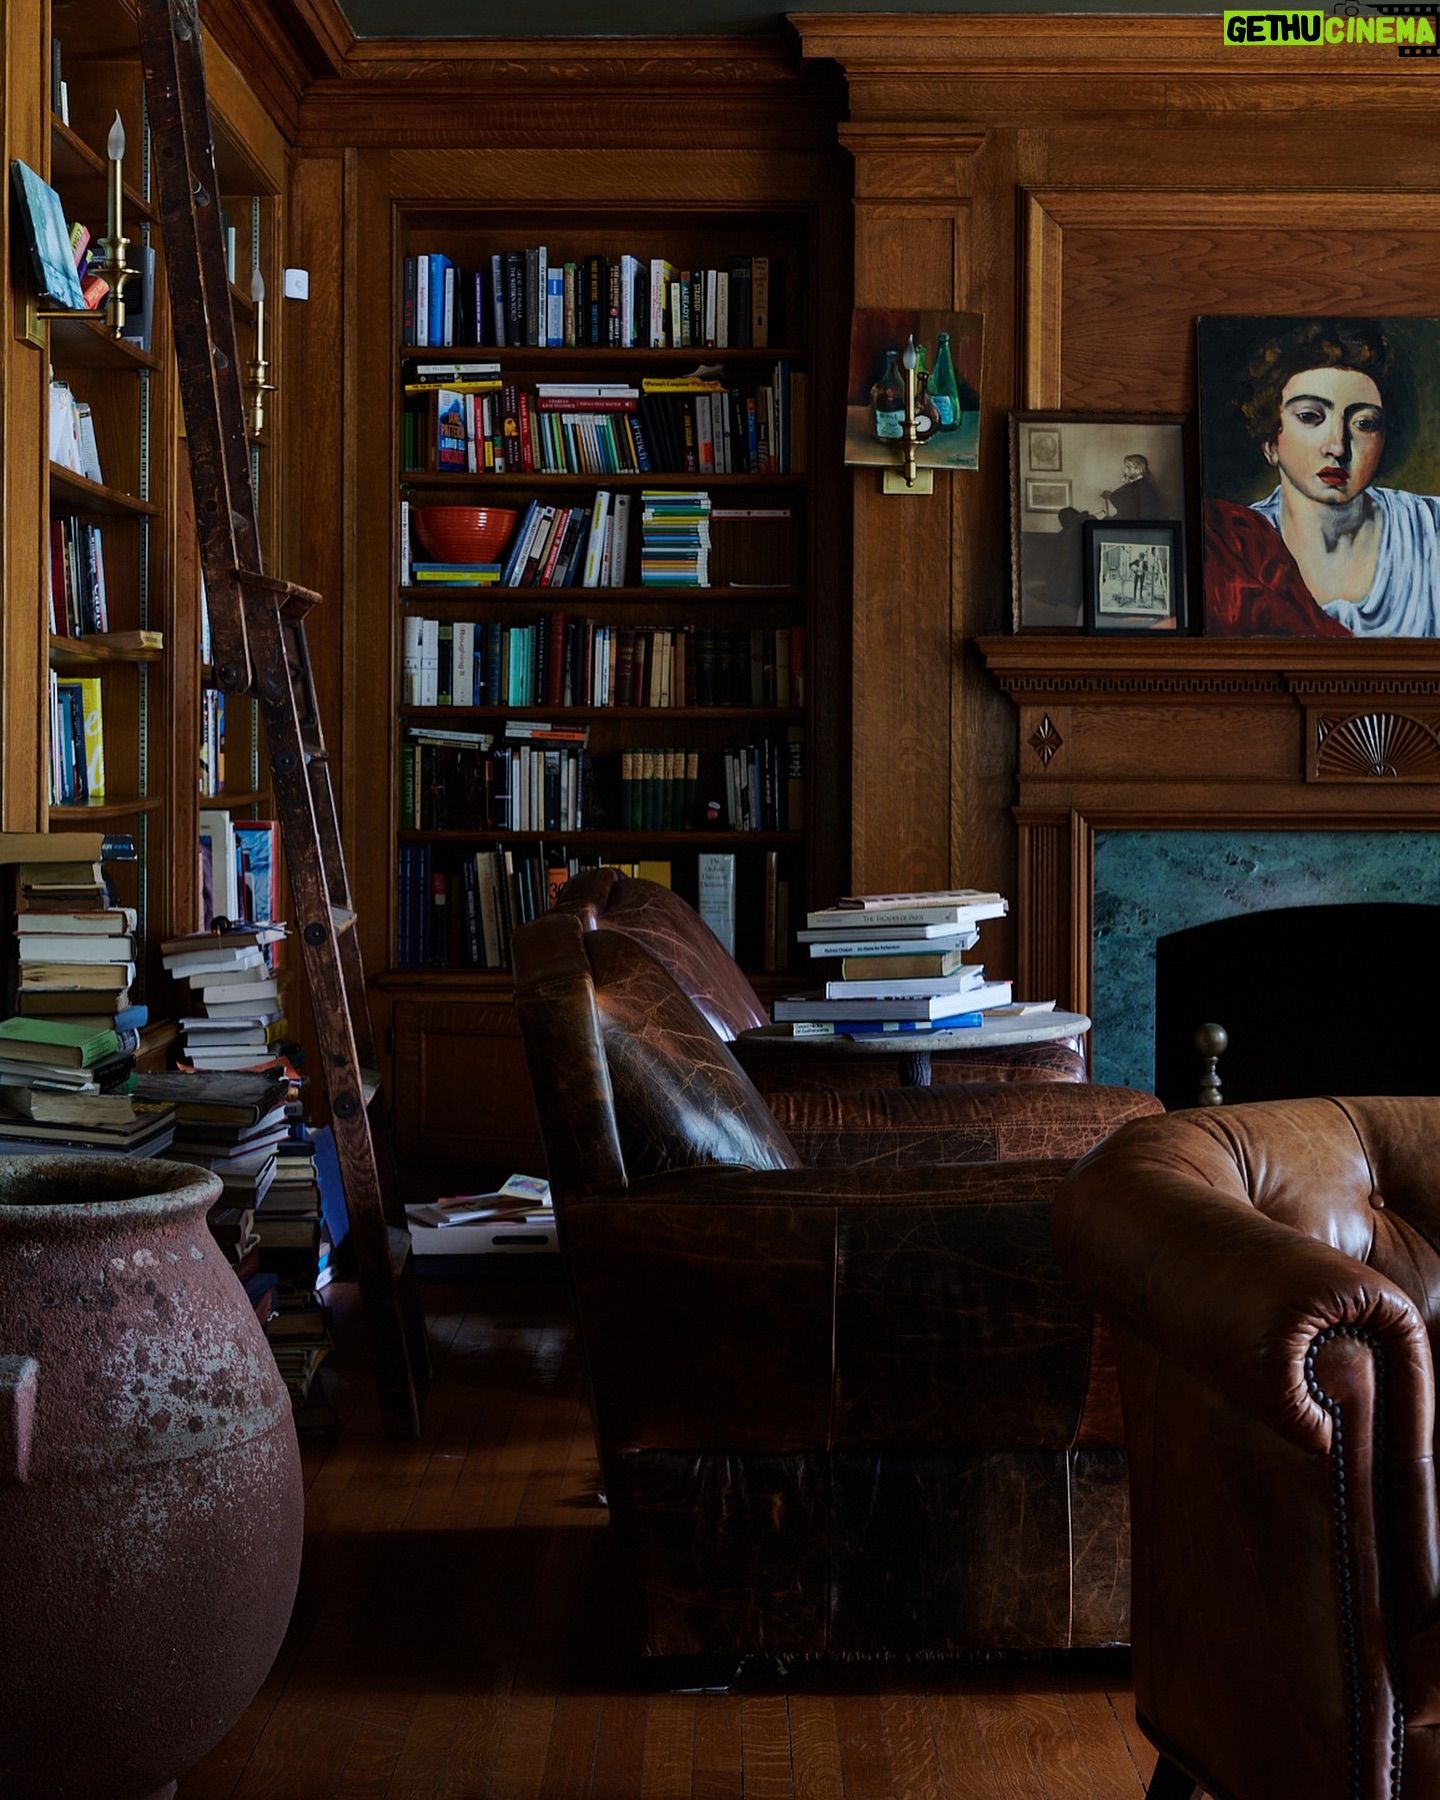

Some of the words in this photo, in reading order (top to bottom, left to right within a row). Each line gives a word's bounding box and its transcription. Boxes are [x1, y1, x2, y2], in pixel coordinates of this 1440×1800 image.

[633, 425, 647, 460] French
[458, 629, 467, 669] Roughing
[863, 914, 876, 922] THE
[907, 913, 924, 921] PARIS
[838, 946, 853, 954] Chapel
